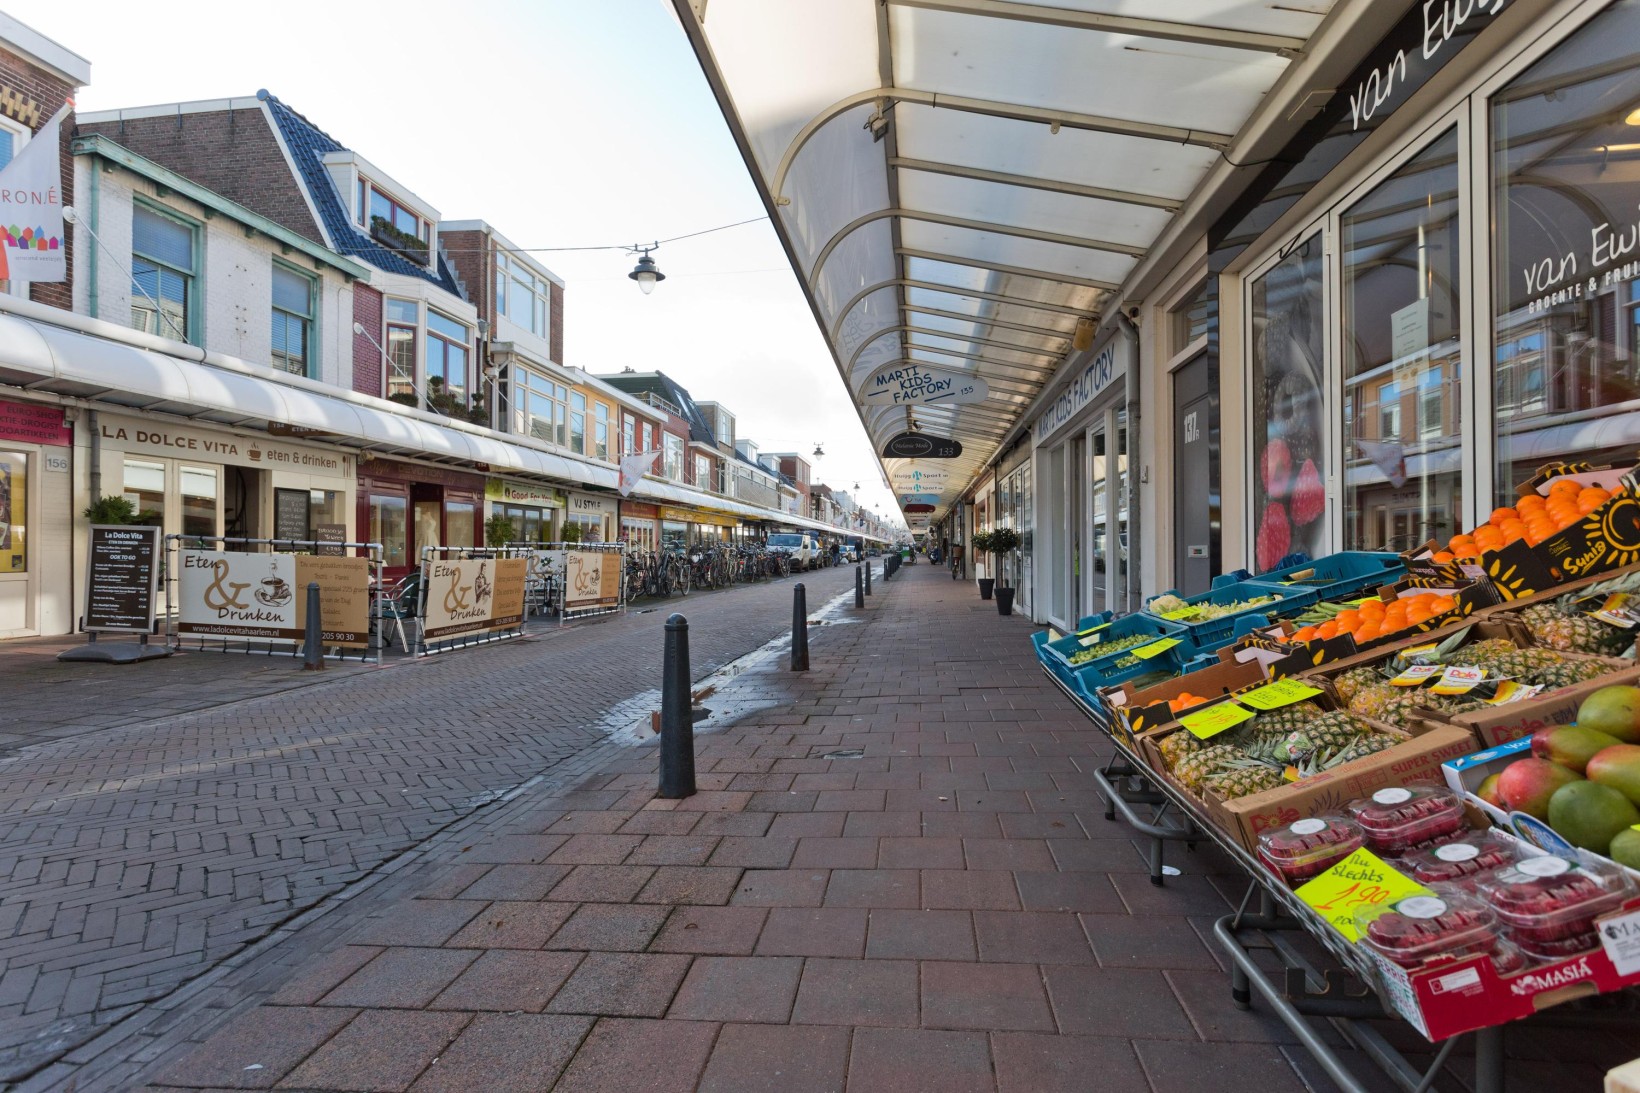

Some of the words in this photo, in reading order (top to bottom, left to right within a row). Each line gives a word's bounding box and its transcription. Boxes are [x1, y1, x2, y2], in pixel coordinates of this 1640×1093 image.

[1350, 49, 1406, 131] van
[1523, 251, 1577, 294] van
[1528, 282, 1581, 314] GROENTE
[1588, 277, 1597, 292] &
[876, 365, 919, 387] MARTI
[899, 373, 932, 390] KIDS
[893, 378, 952, 403] FACTORY
[960, 386, 974, 396] 135
[1038, 404, 1055, 439] MARTI
[1055, 389, 1072, 424] KIDS
[1073, 342, 1115, 409] FACTORY
[102, 425, 128, 441] LA
[136, 430, 198, 450] DOLCE
[203, 440, 239, 455] VITA
[267, 449, 290, 463] eten
[292, 451, 300, 464] &
[302, 453, 337, 469] drinken
[938, 447, 954, 456] 133
[47, 458, 68, 469] 156
[511, 489, 528, 500] Good
[574, 498, 581, 508] VJ
[130, 532, 143, 540] Vita
[185, 555, 221, 569] Eten
[1563, 540, 1606, 575] Sunia
[434, 565, 456, 578] Eten
[574, 557, 589, 592] &
[203, 559, 252, 610] &
[443, 566, 472, 613] &
[218, 606, 285, 622] Drinken
[450, 606, 486, 621] Drinken
[192, 624, 280, 638] www.ladolcevitahaarlem.nl
[322, 632, 334, 640] 205
[345, 633, 355, 641] 30
[1449, 669, 1478, 680] Dole
[1490, 718, 1544, 746] Dole
[1391, 754, 1431, 776] SUPER
[1431, 740, 1472, 762] SWEET
[1250, 805, 1300, 835] Dole
